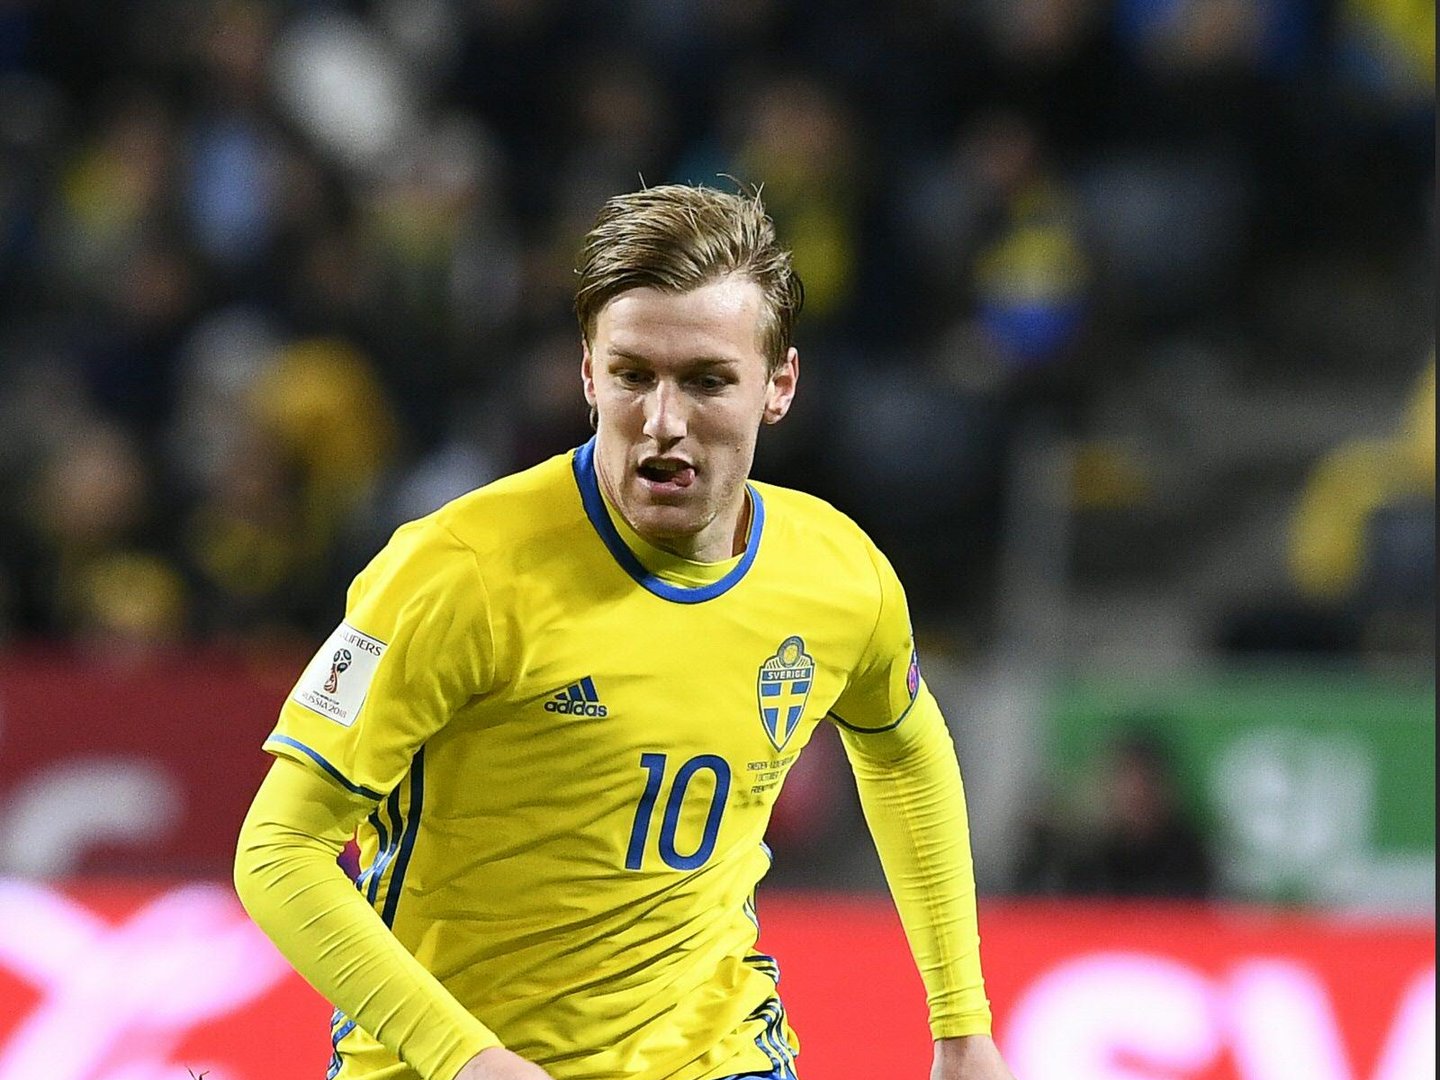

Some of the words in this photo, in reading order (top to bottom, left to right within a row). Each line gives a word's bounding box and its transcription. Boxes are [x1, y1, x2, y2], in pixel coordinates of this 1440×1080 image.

[767, 669, 807, 680] SVERIGE
[543, 699, 608, 718] adidas
[624, 752, 732, 871] 10
